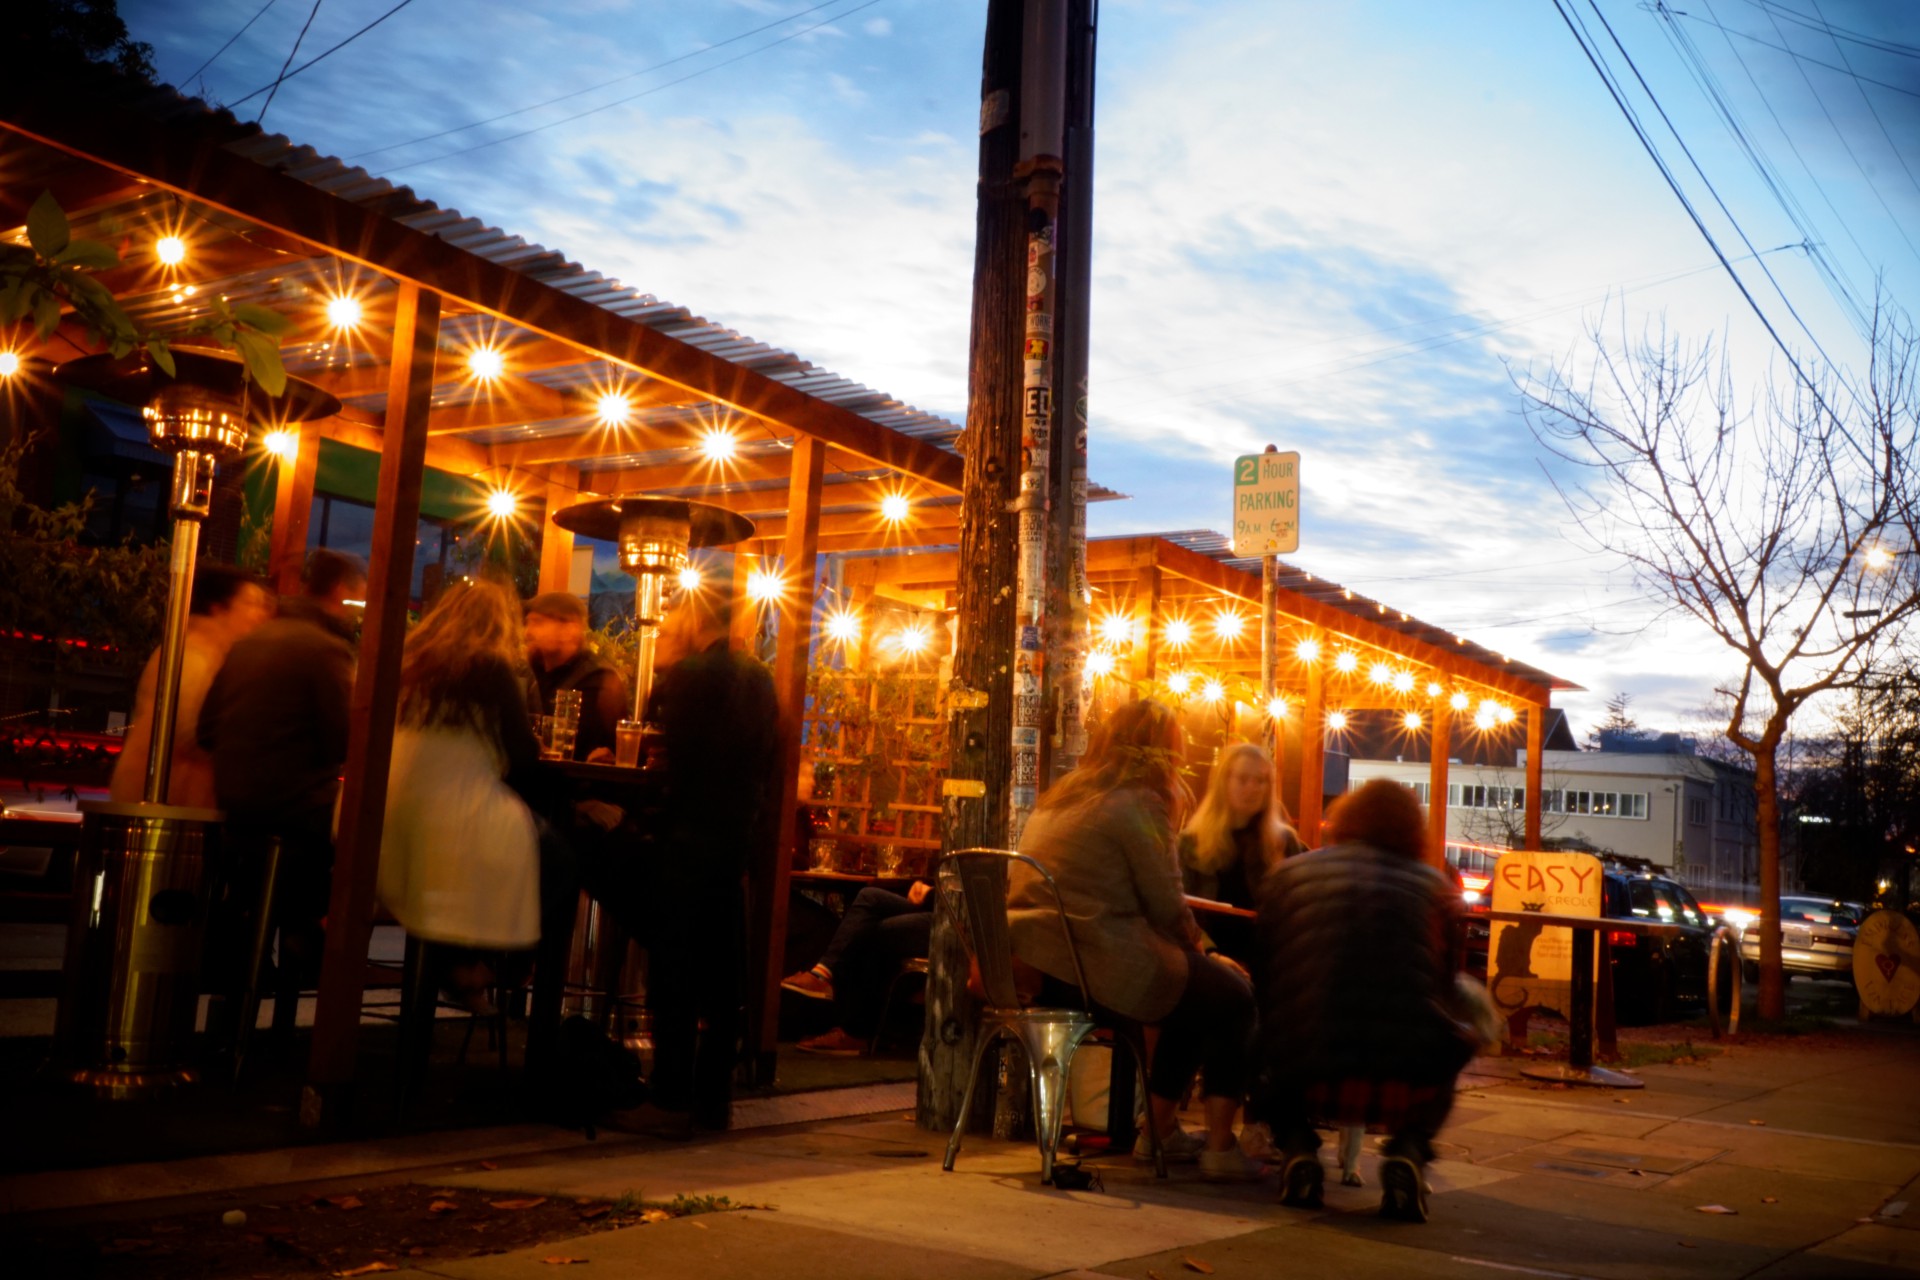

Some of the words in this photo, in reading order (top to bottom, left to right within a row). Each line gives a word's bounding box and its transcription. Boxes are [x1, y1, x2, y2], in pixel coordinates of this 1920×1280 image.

[1241, 460, 1255, 482] 2
[1263, 462, 1293, 479] HOUR
[1240, 489, 1294, 511] PARKING
[1270, 518, 1295, 533] 6M
[1502, 863, 1594, 894] EASY
[1548, 896, 1596, 907] CREOLE
